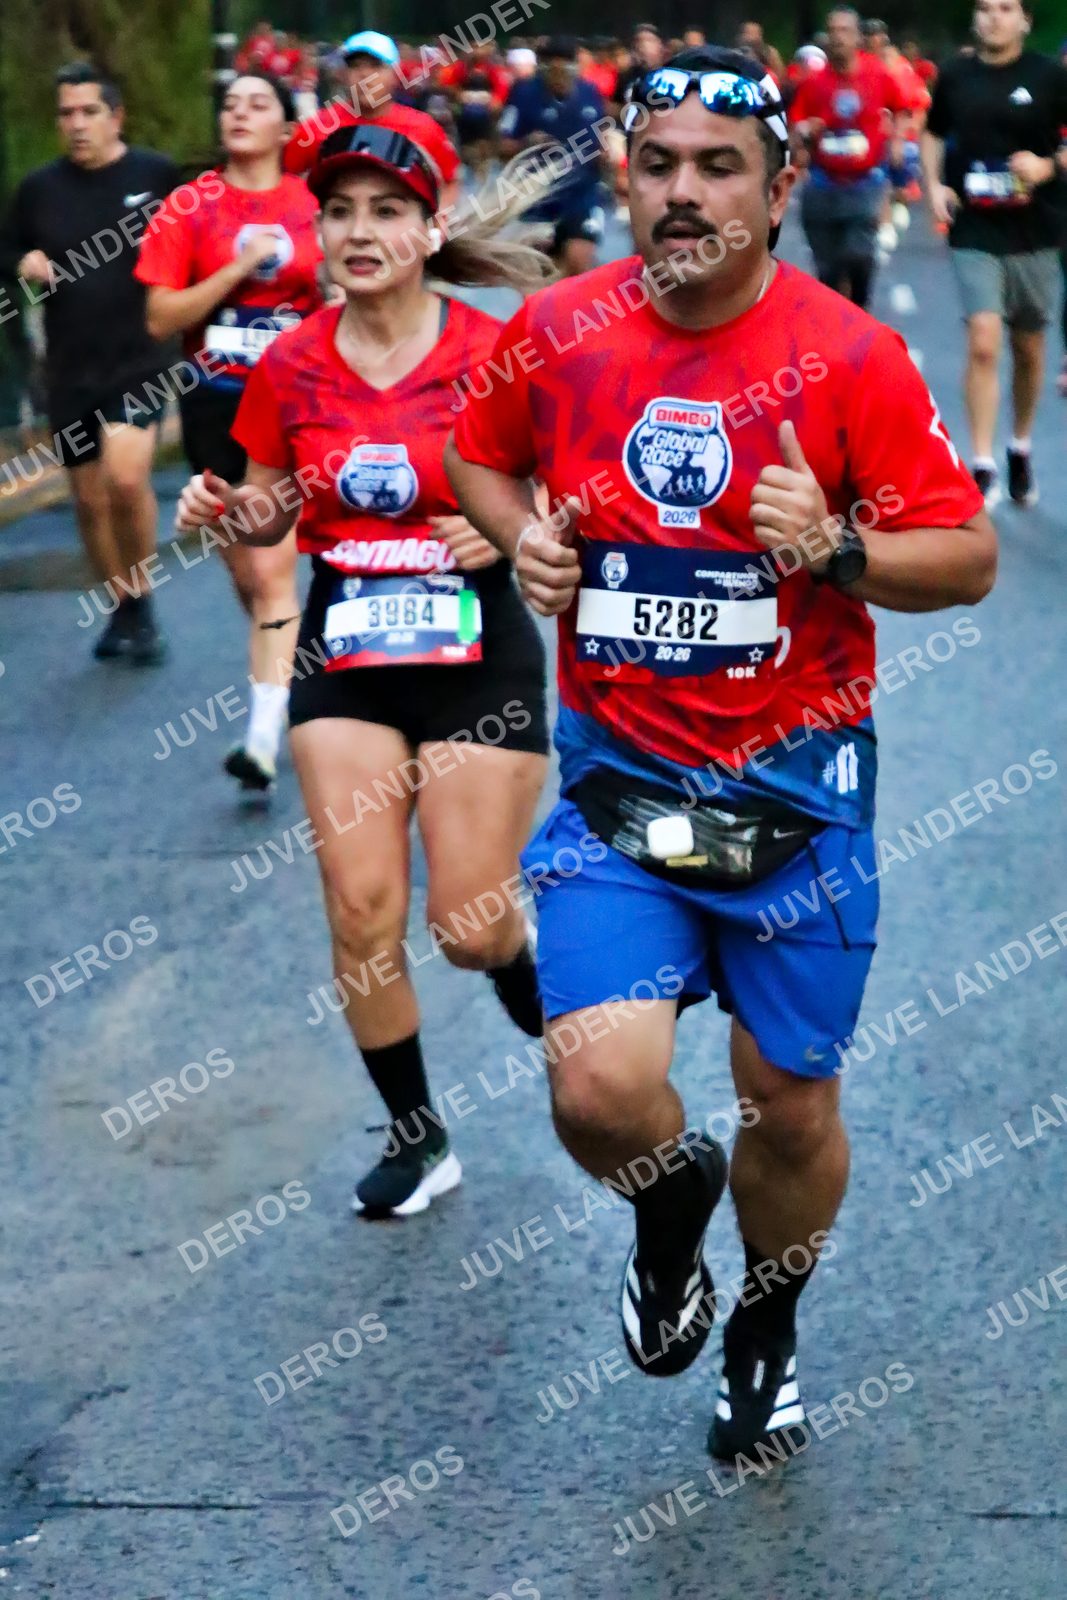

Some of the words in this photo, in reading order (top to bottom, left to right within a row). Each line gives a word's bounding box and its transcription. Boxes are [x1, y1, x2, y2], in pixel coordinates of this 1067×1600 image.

[656, 409, 711, 426] BIMBO
[652, 429, 709, 454] Global
[640, 445, 687, 468] Race
[663, 510, 697, 523] 2026
[633, 597, 718, 640] 5282
[726, 666, 756, 679] 10K
